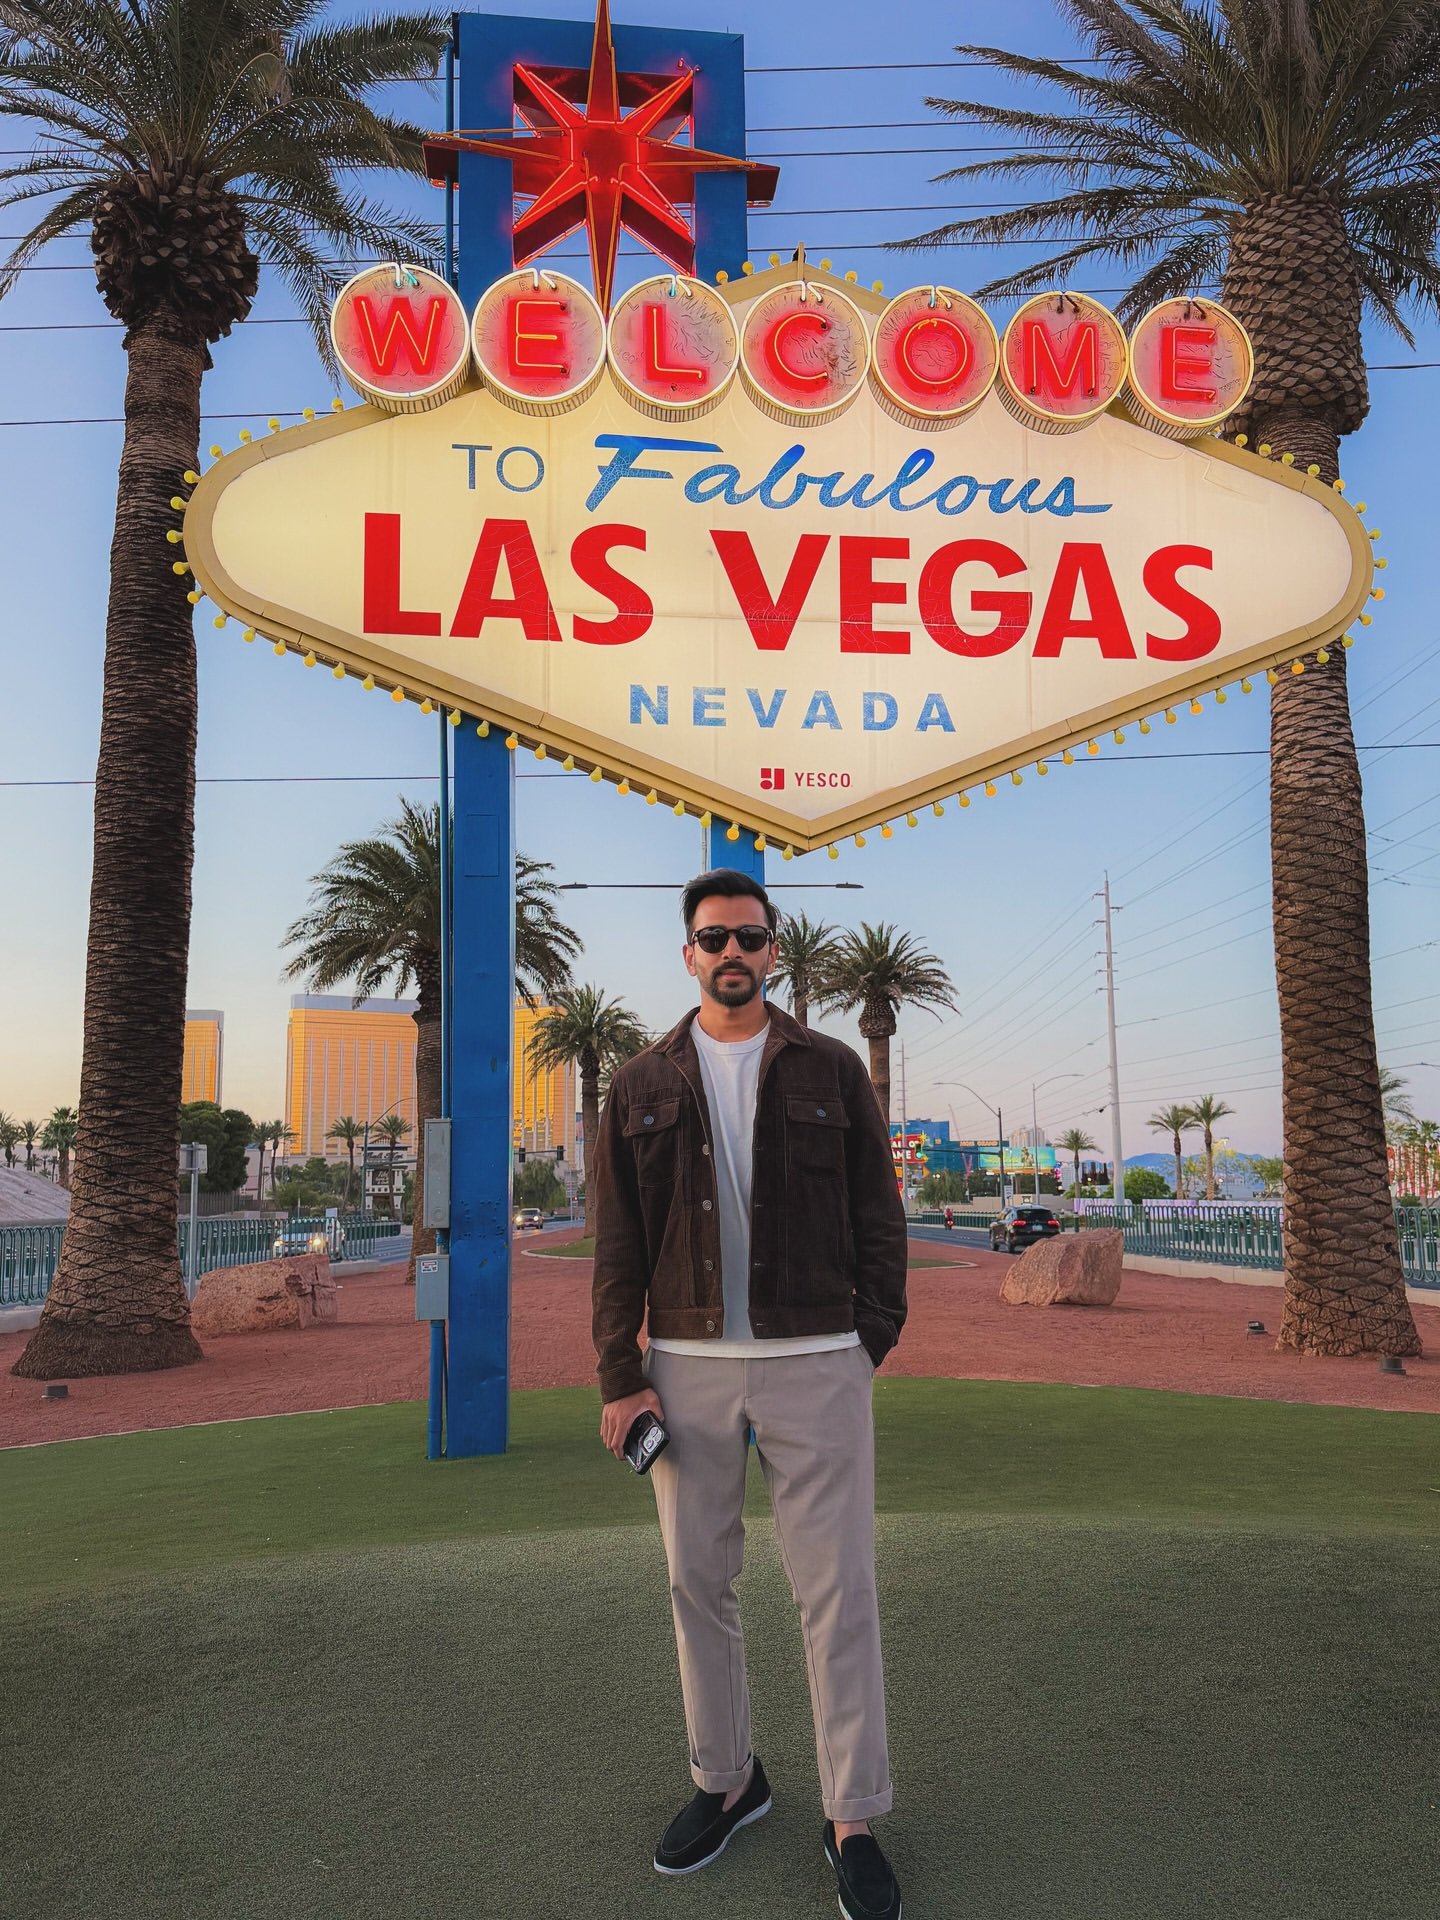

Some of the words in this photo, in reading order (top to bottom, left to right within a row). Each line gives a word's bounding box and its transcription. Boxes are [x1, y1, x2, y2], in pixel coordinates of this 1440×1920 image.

[353, 294, 1217, 403] WELCOME
[453, 444, 544, 493] TO
[585, 433, 1113, 518] Fabulous
[363, 512, 654, 646] LAS
[709, 529, 1222, 662] VEGAS
[629, 684, 956, 733] NEVADA
[795, 772, 851, 788] YESCO
